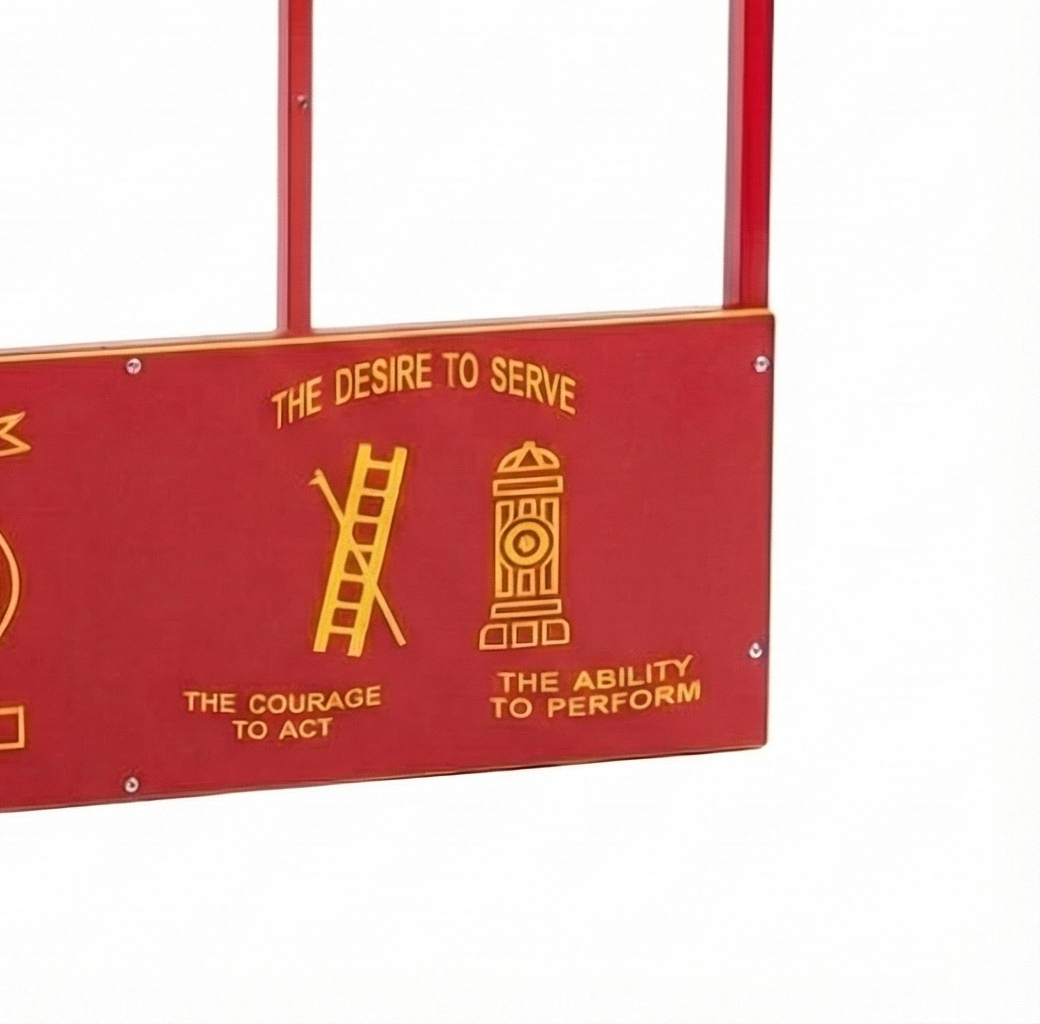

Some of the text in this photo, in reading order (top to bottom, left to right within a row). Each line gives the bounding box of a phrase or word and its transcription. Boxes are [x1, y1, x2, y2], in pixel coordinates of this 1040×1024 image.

[271, 352, 577, 429] THE DESIRE TO SERVE
[495, 654, 694, 694] THE ABILITY
[183, 685, 382, 716] THE COURAGE
[489, 679, 702, 719] TO PERFORM
[232, 716, 334, 741] TO ACT
